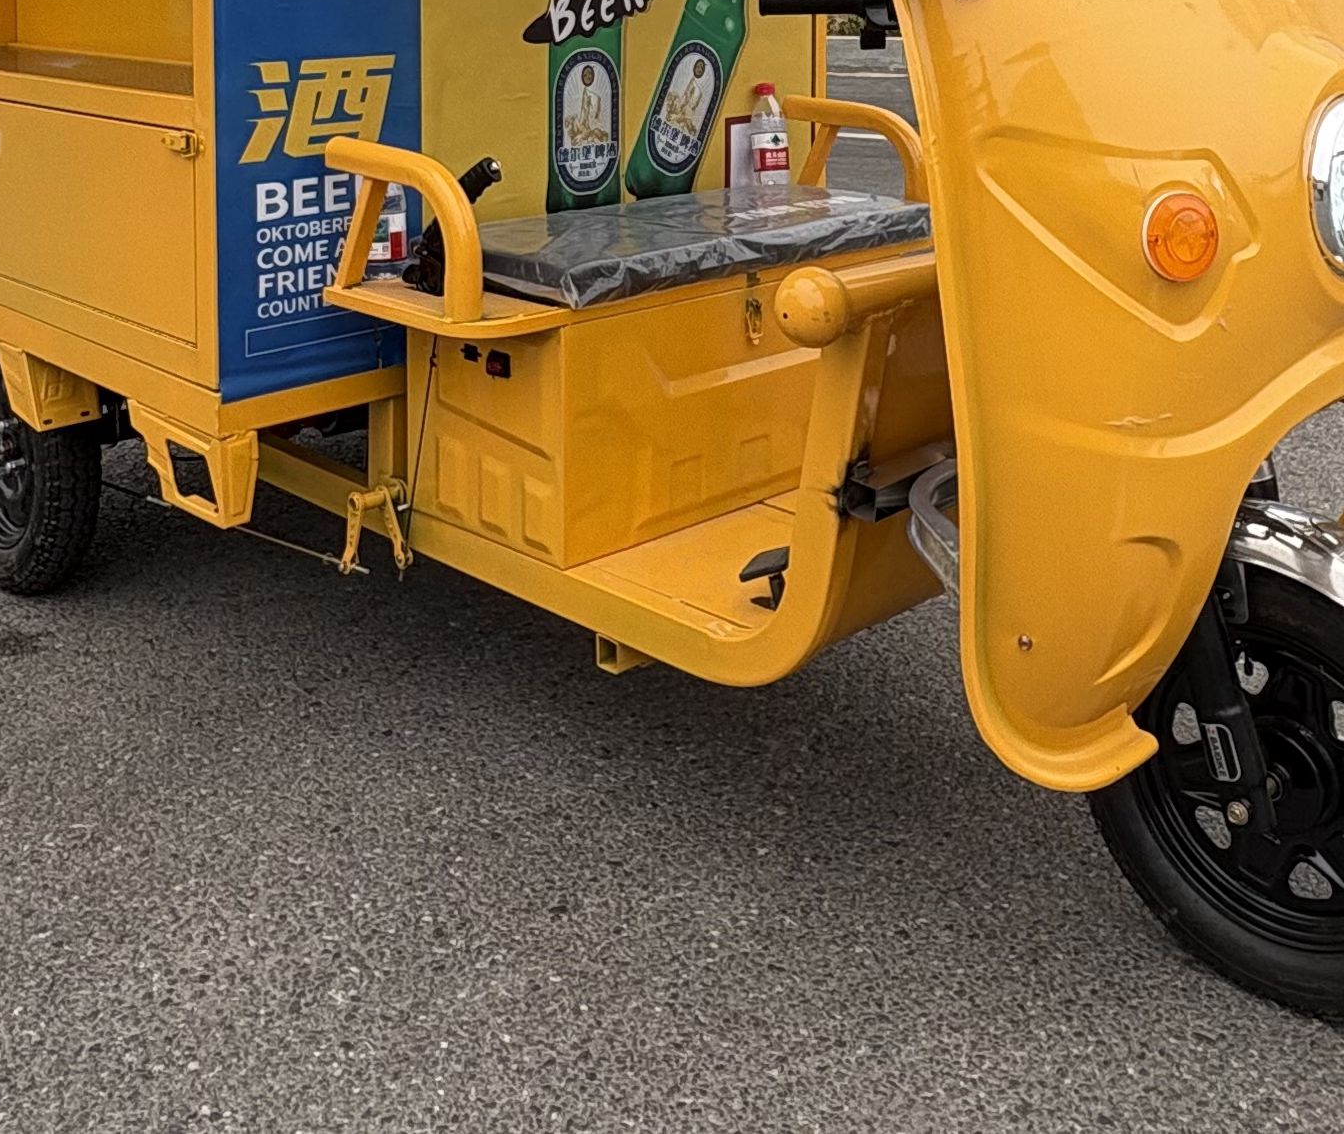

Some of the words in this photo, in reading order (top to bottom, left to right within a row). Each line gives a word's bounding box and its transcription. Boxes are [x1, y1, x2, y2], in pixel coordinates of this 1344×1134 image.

[238, 54, 396, 165] 酒
[257, 239, 329, 269] COME
[257, 293, 331, 319] COUNT
